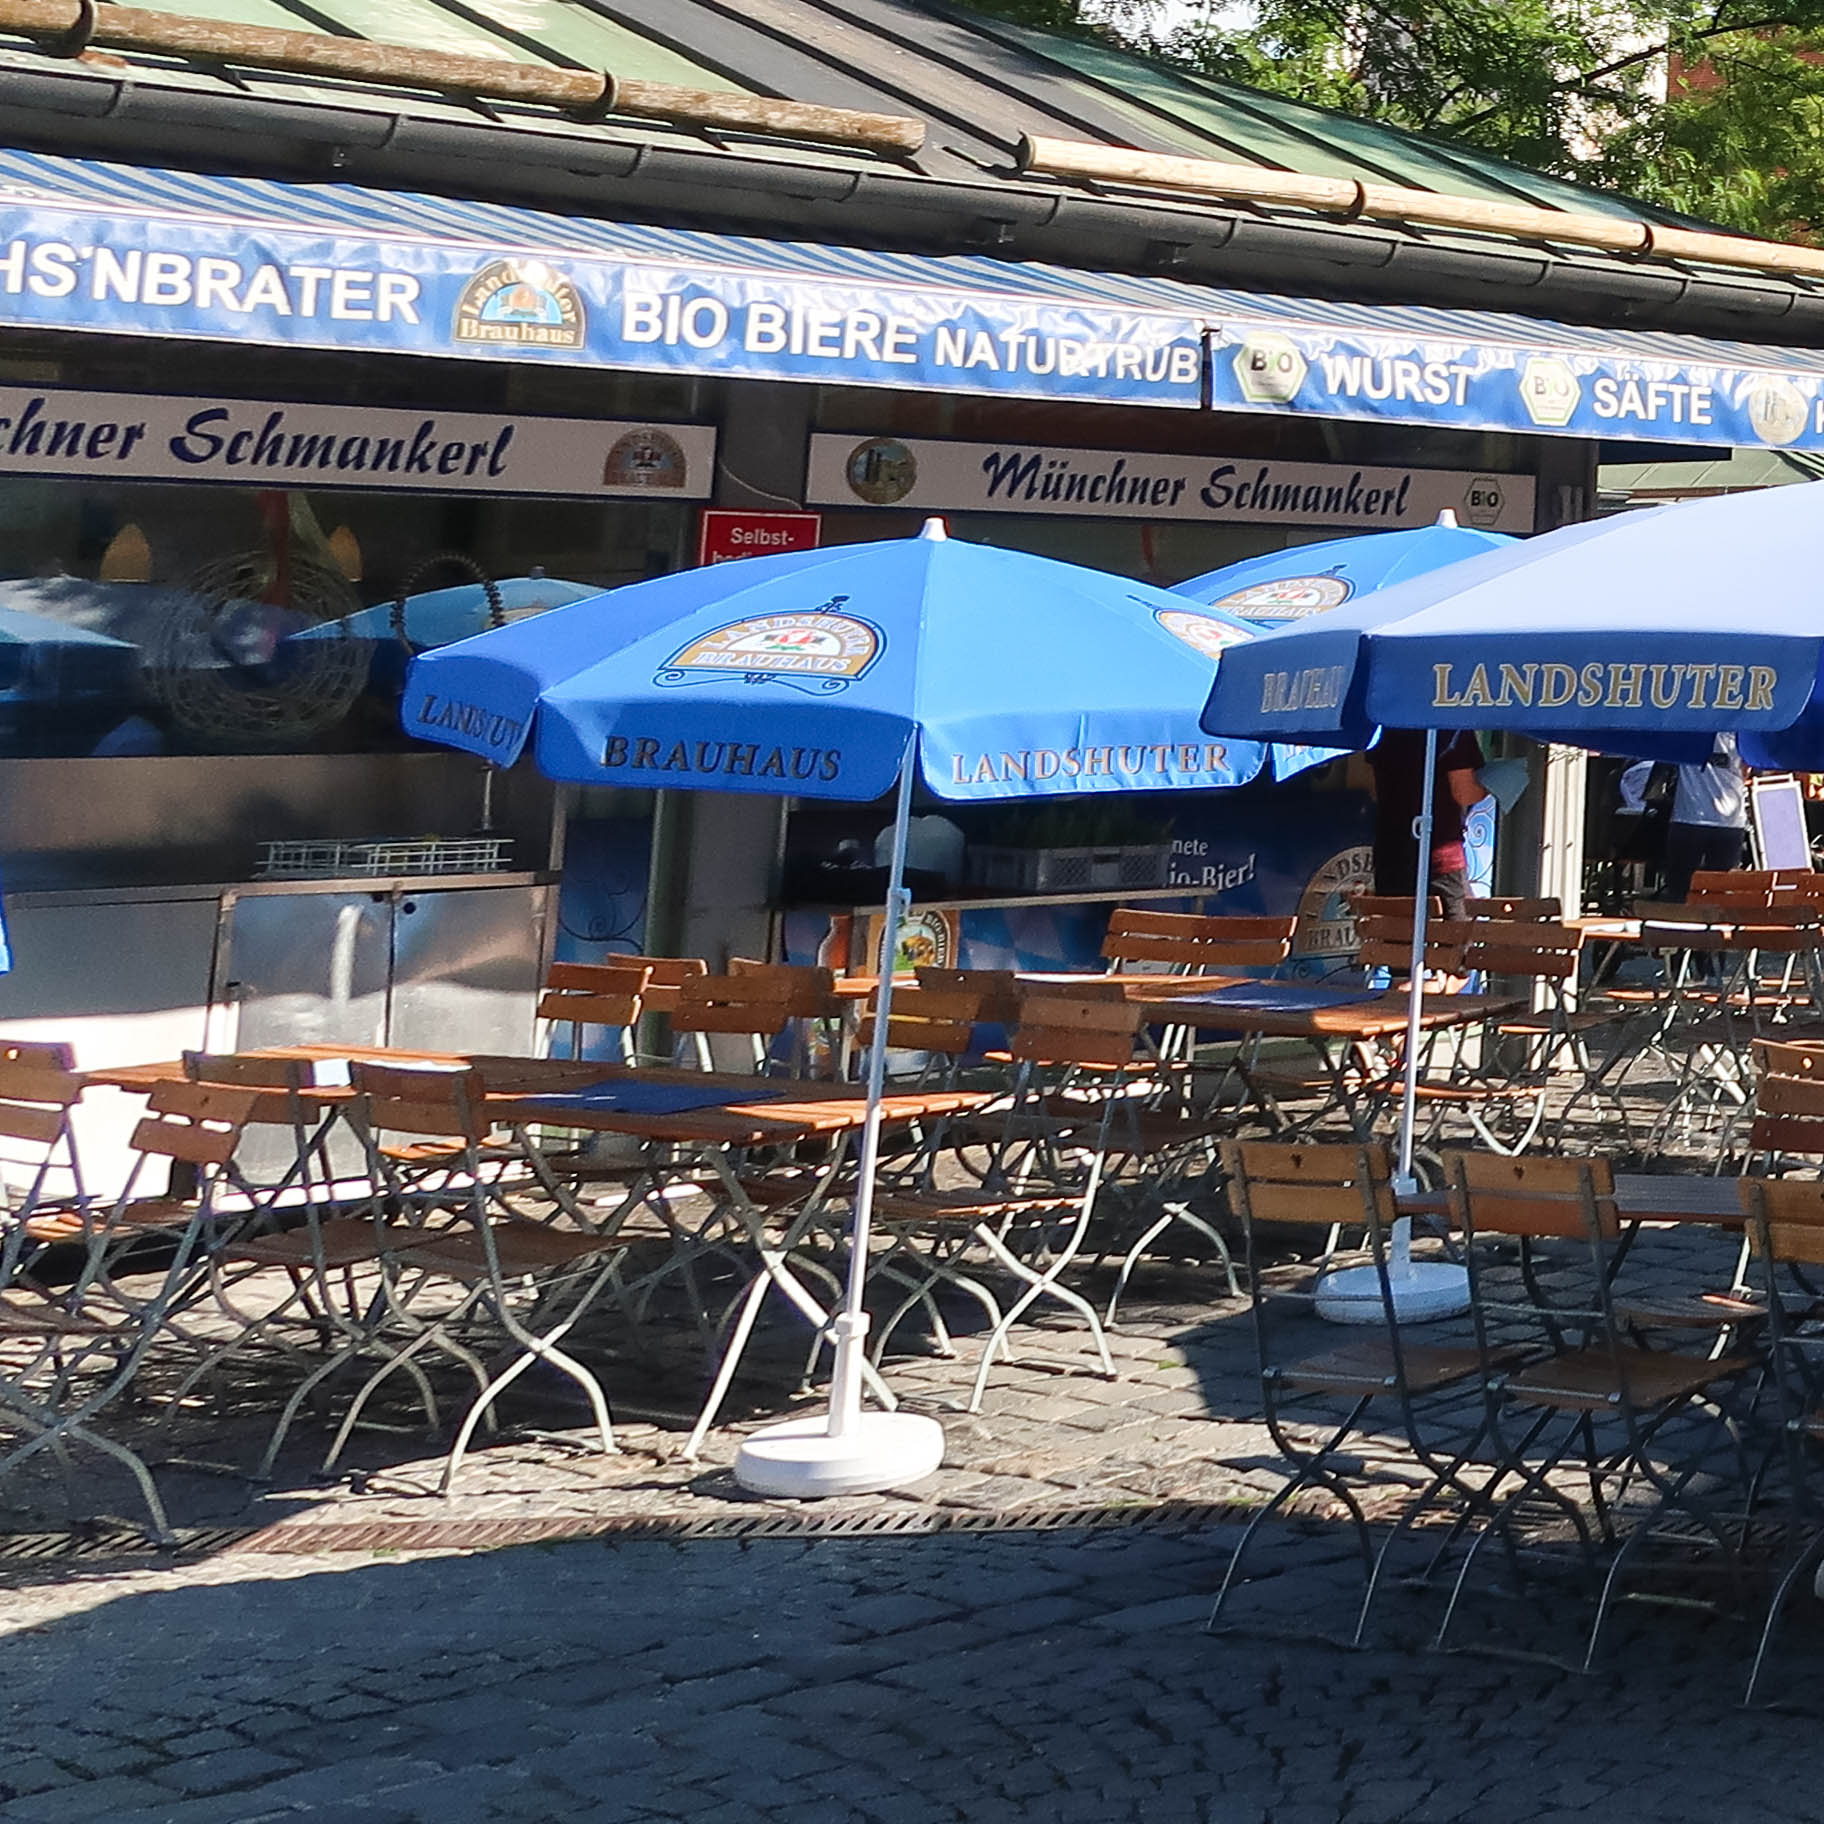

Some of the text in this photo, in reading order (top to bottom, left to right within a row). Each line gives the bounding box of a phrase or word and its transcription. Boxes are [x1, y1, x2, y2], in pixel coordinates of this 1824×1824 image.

[460, 318, 576, 344] Brauhaus
[622, 291, 728, 349] BIO
[745, 301, 918, 364] BIERE
[1324, 354, 1478, 407] WURST
[1593, 371, 1713, 425] SÄFTE
[170, 407, 516, 479] Schmankerl
[982, 451, 1187, 508] Münchner
[1201, 464, 1411, 517] Schmankerl
[731, 527, 795, 546] Selbst-
[1433, 663, 1778, 711] LANDSHUTER
[602, 735, 842, 782] BRAUHAUS
[953, 742, 1231, 785] LANDSHUTER
